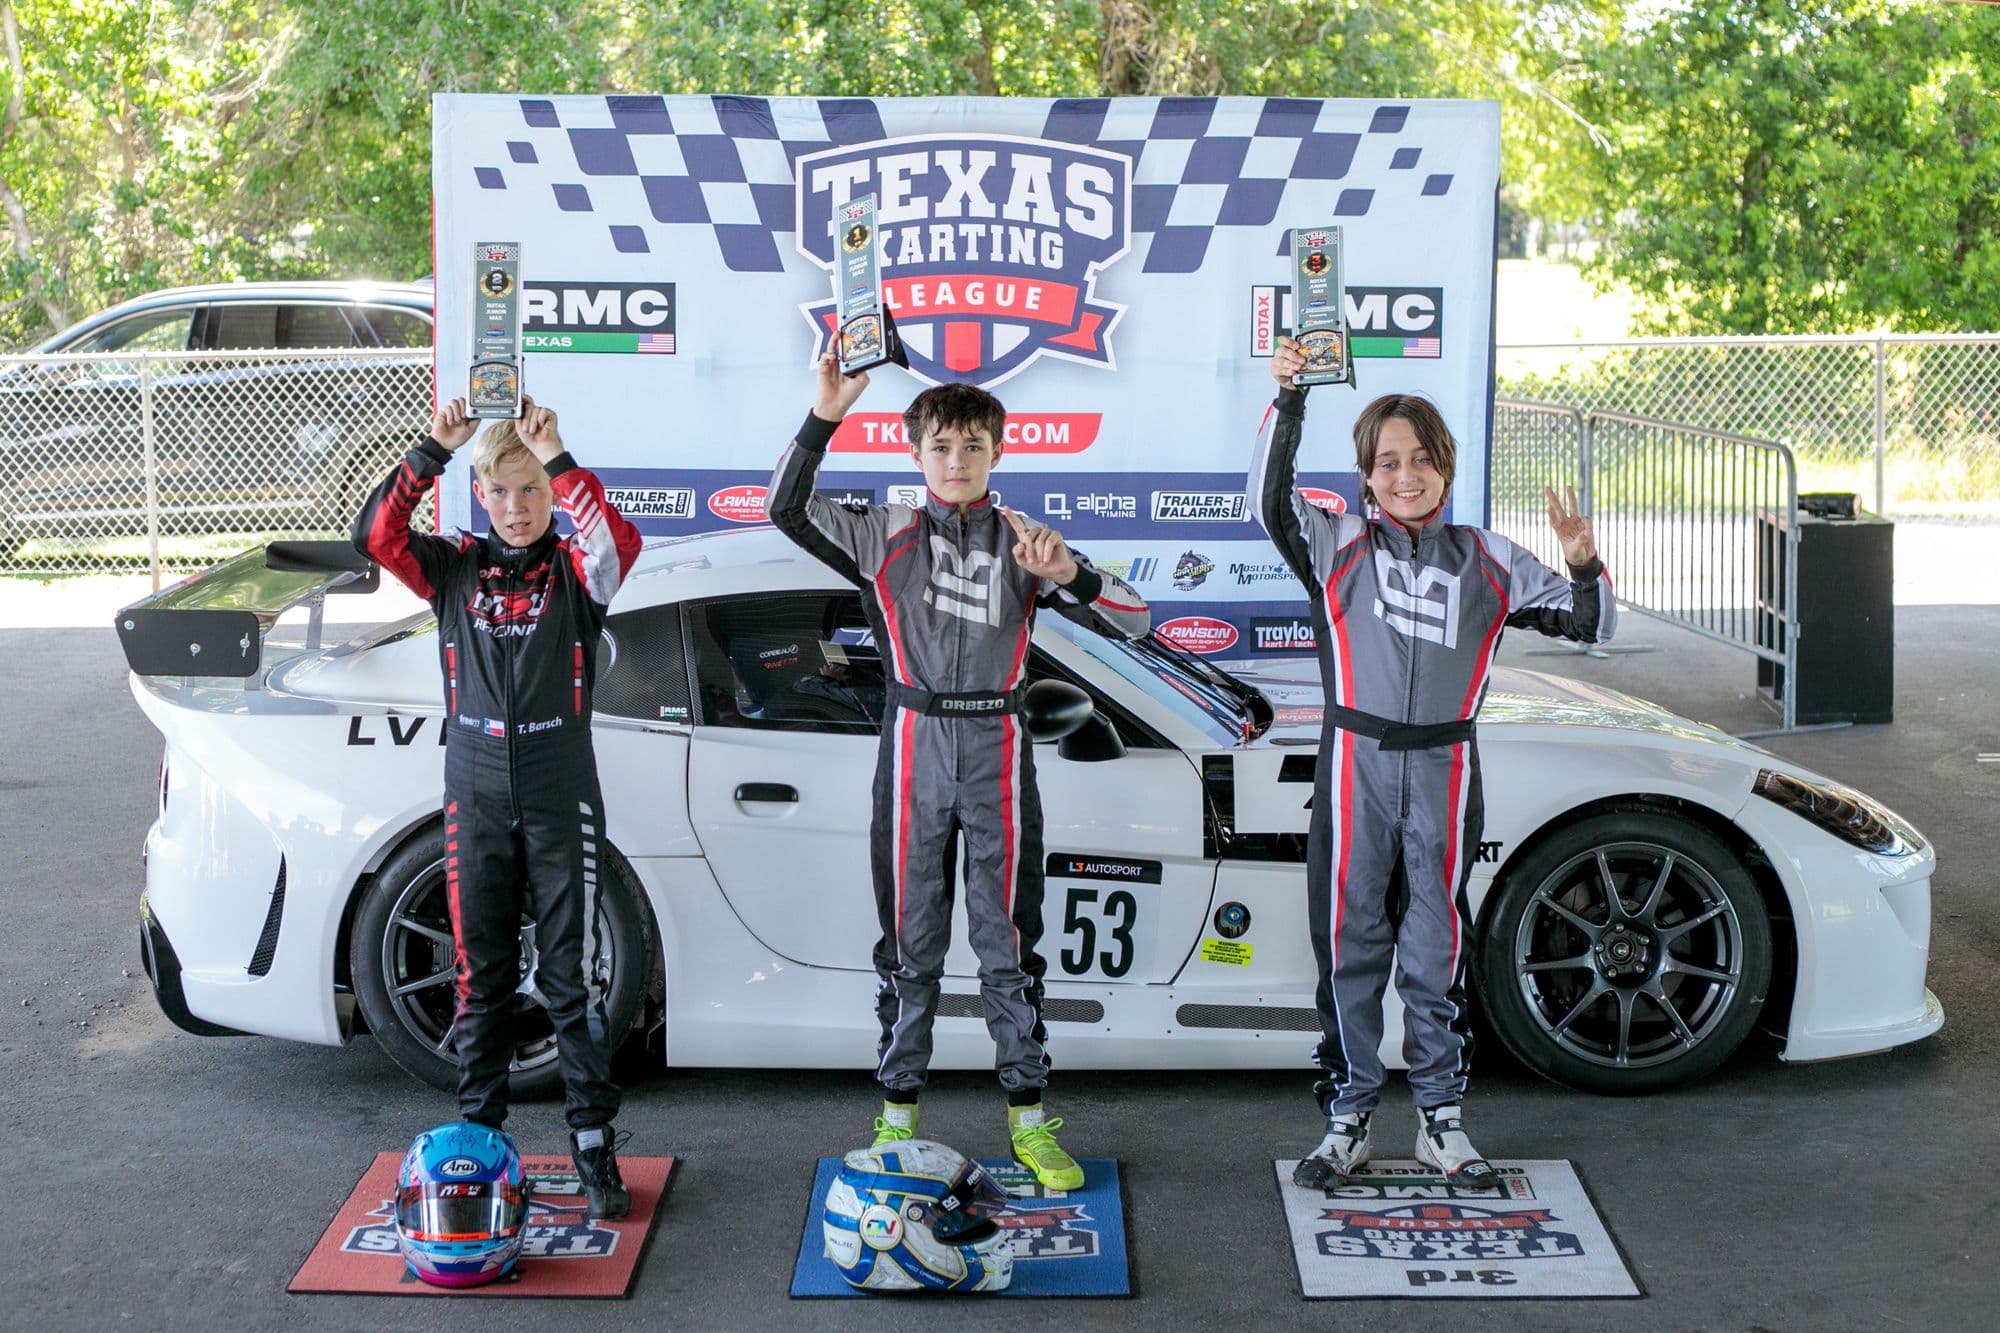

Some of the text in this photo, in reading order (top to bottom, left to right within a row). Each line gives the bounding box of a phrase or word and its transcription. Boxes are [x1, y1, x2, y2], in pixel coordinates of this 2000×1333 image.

[812, 150, 1114, 241] TEXAS
[879, 224, 1064, 270] KARTING
[885, 282, 1042, 311] LEAGUE
[523, 289, 669, 326] RMC
[1281, 294, 1436, 331] MC
[1257, 295, 1269, 350] ROTAX
[606, 491, 675, 502] TRAILER-
[713, 496, 766, 507] LAWS
[1076, 493, 1136, 515] alpha
[1163, 496, 1231, 506] TRAILER-
[1169, 507, 1230, 518] ALARMS
[1229, 563, 1275, 574] MOSLEY
[1160, 627, 1232, 639] LAWSON
[942, 699, 1005, 710] ORBEZO
[528, 716, 563, 734] Barsch
[1085, 863, 1143, 877] AUTOSPORT
[1060, 888, 1138, 979] 53
[448, 1160, 476, 1172] Arai
[1362, 1228, 1528, 1242] KARTING
[1326, 1234, 1576, 1260] TEXAS
[1406, 1269, 1518, 1287] 3rd
